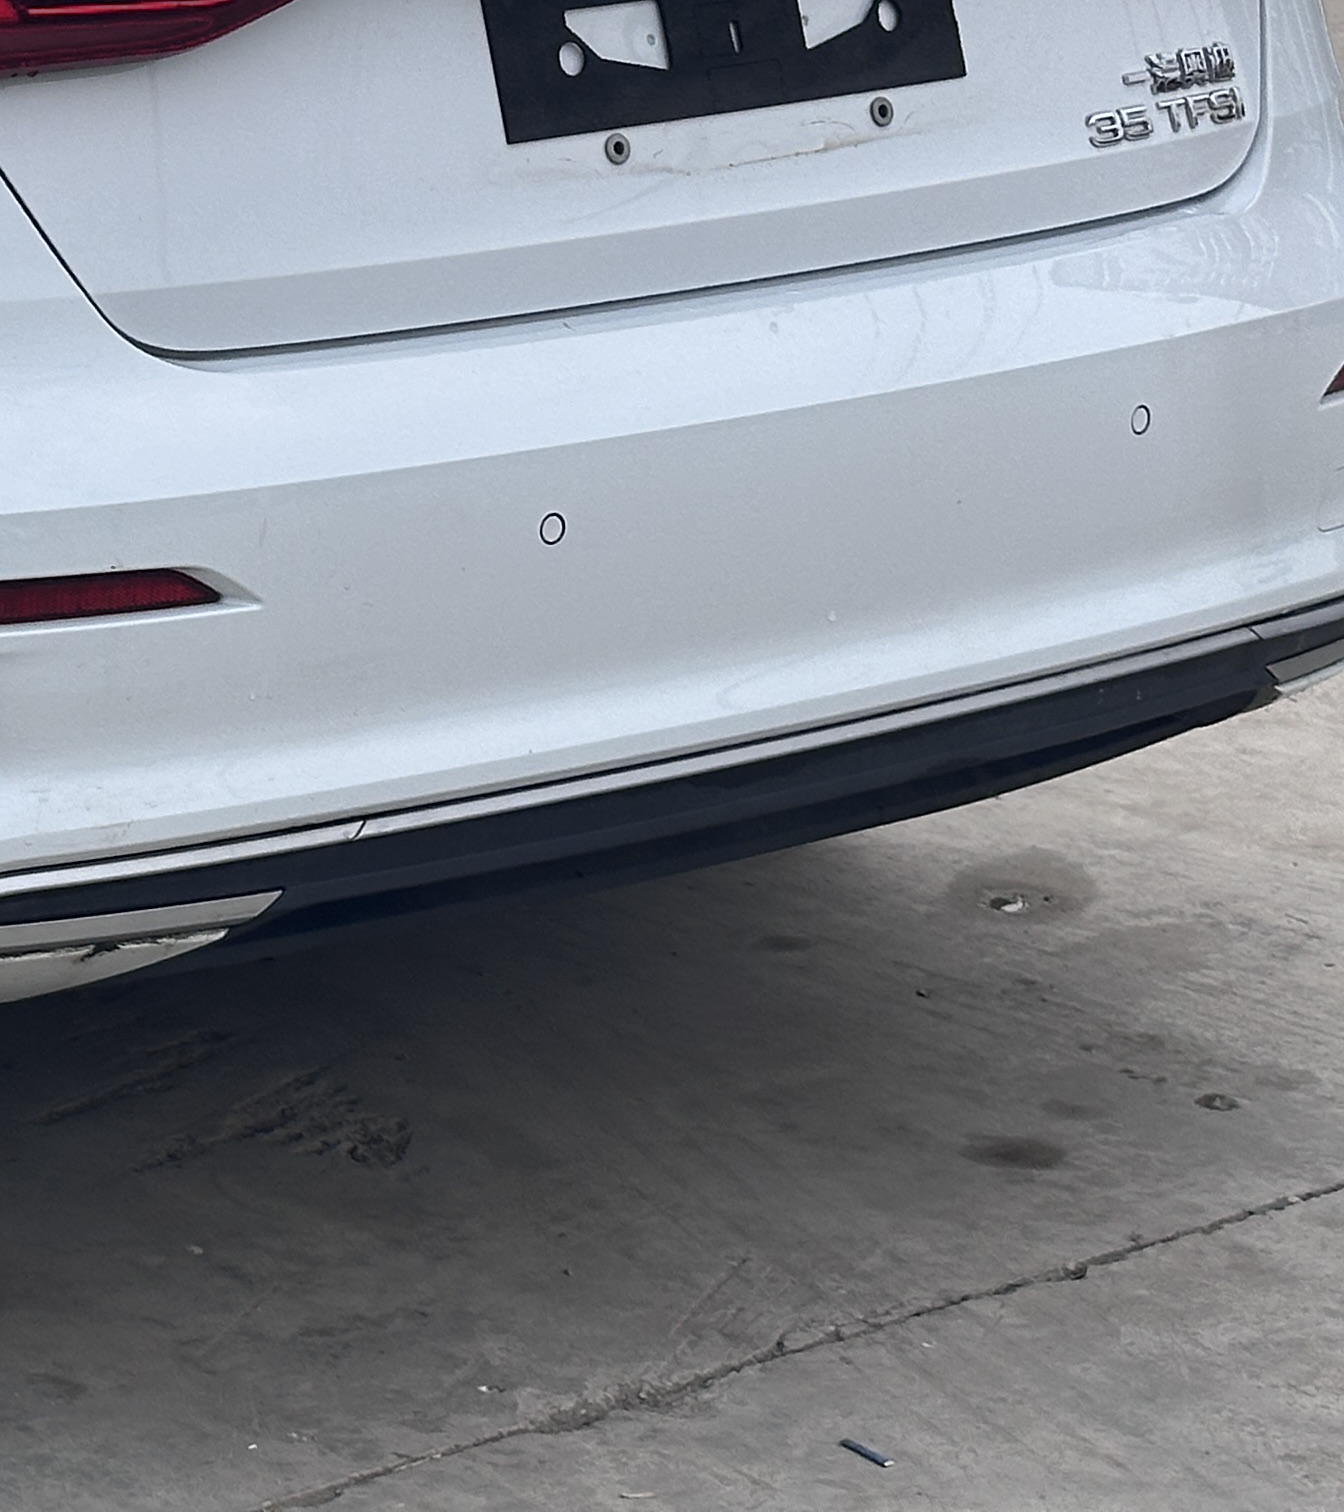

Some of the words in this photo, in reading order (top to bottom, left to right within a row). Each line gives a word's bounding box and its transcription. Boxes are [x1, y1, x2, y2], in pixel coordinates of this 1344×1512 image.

[1122, 42, 1236, 95] 一汽奥迪
[1085, 104, 1154, 149] 35
[1155, 86, 1246, 133] TFSI
